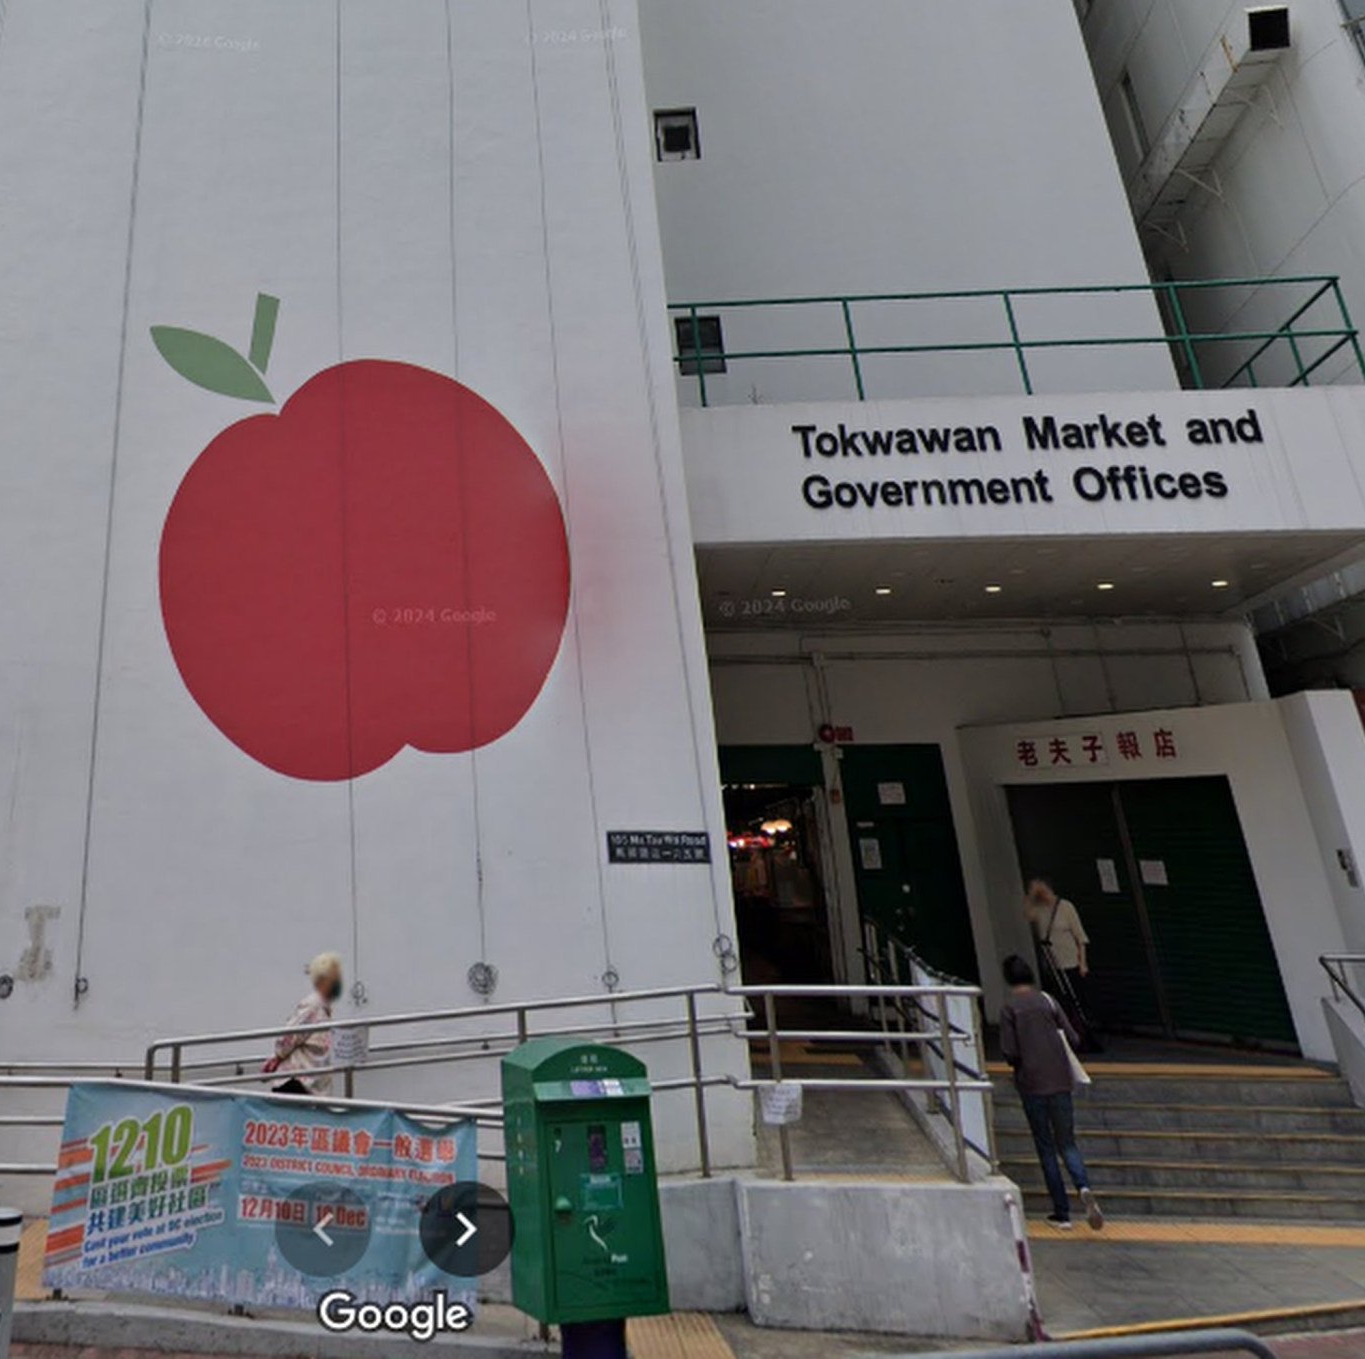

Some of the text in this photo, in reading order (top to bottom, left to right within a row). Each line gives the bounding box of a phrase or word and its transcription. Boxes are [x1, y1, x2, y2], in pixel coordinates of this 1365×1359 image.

[791, 408, 1264, 458] Tokwawan Market and
[802, 465, 1229, 510] Government Offices
[1017, 727, 1177, 767] 老夫子報店
[90, 1105, 192, 1185] 1210
[244, 1120, 457, 1163] 2023年區議會一般選舉
[270, 1157, 313, 1173] DISTRICT
[87, 1185, 207, 1235] 共建美好社區
[241, 1197, 306, 1222] 12月10日
[335, 1206, 367, 1227] Dec
